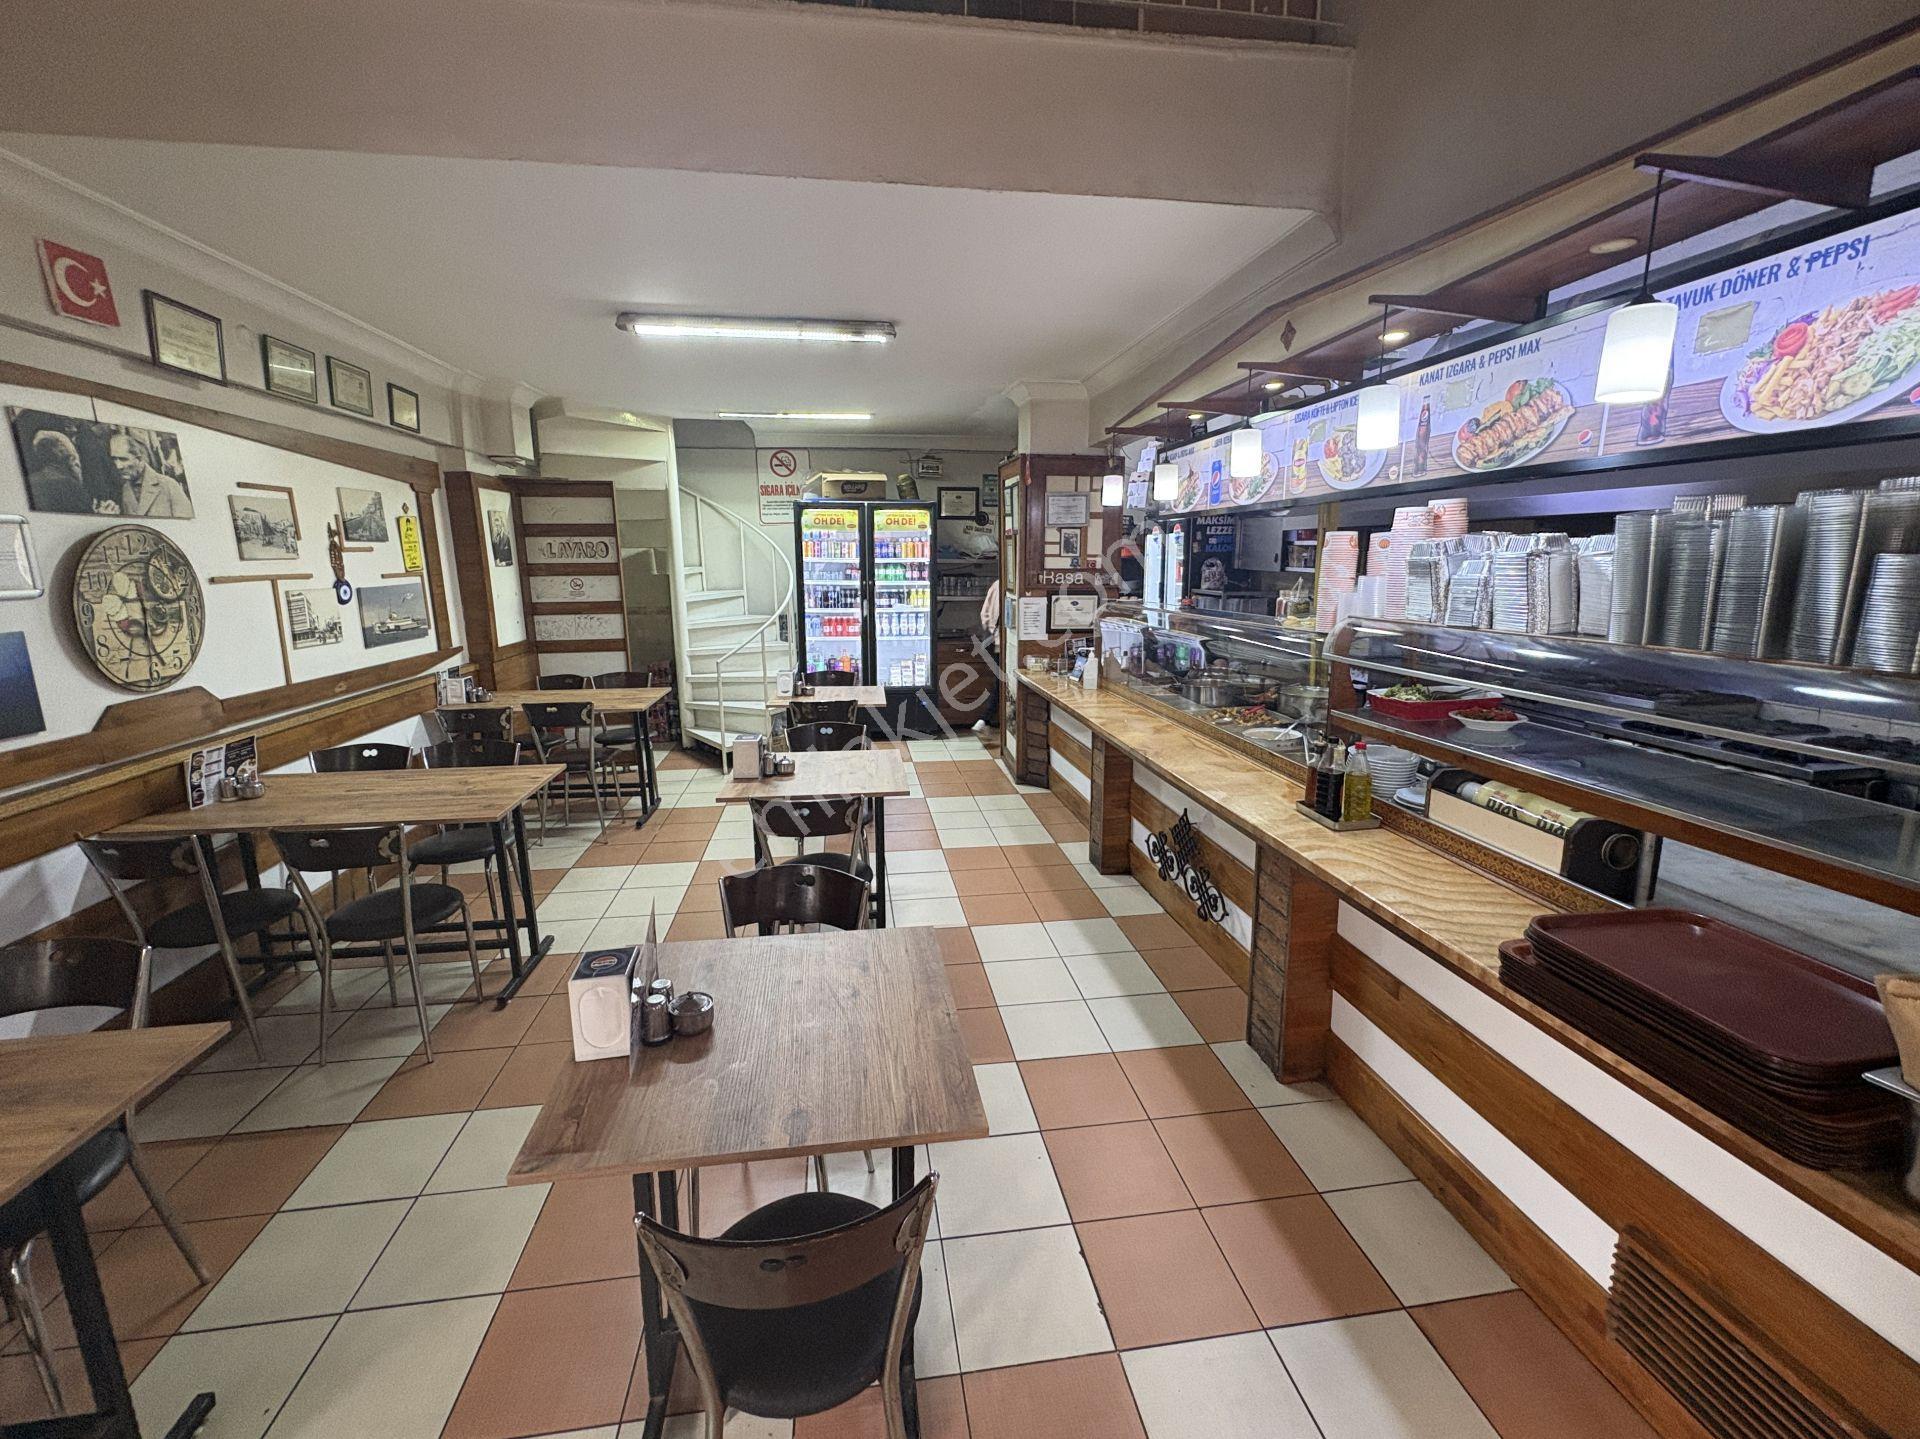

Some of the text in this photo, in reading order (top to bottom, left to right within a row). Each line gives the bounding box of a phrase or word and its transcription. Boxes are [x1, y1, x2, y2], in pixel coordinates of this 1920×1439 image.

[1719, 263, 1782, 298] DÖNER
[1786, 255, 1801, 278] &
[1805, 235, 1870, 273] PEPSI
[1419, 336, 1541, 387] KANAT IZGARA & PEPSI MAX
[814, 517, 845, 525] OH DE!
[885, 517, 916, 525] OH DE!
[102, 545, 120, 564] 11
[124, 534, 149, 555] 12
[159, 544, 168, 565] 1
[545, 541, 610, 559] LAVABO
[86, 571, 108, 591] 10
[177, 567, 189, 588] 2
[82, 602, 94, 627] 9
[96, 634, 110, 658] 8
[119, 657, 130, 679] 7
[169, 649, 183, 670] 5
[149, 661, 161, 682] 6
